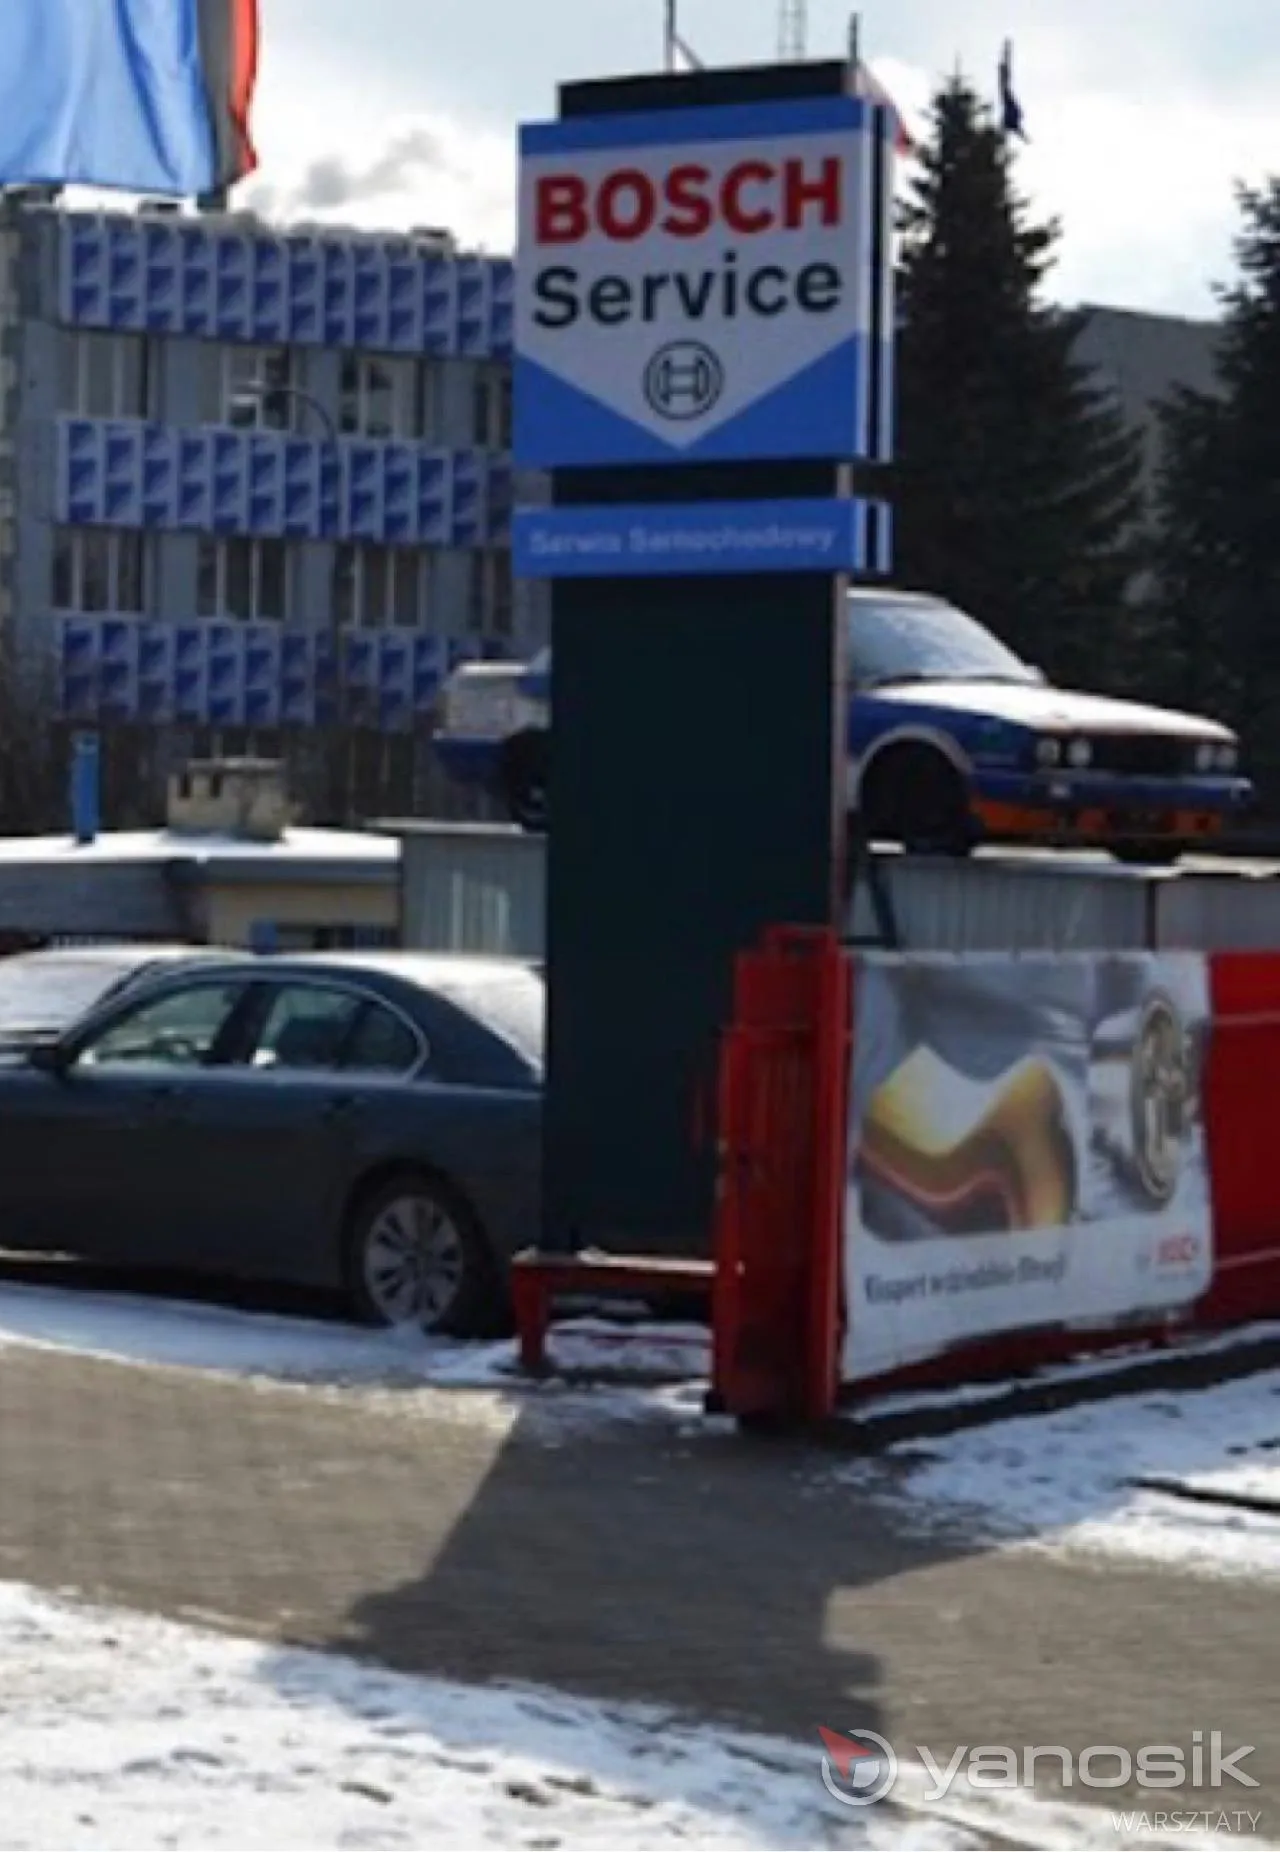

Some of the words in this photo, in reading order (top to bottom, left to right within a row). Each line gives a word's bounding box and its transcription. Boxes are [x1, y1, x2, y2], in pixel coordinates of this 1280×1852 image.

[535, 156, 841, 245] BOSCH
[532, 251, 842, 329] Service
[530, 528, 621, 555] Serwis
